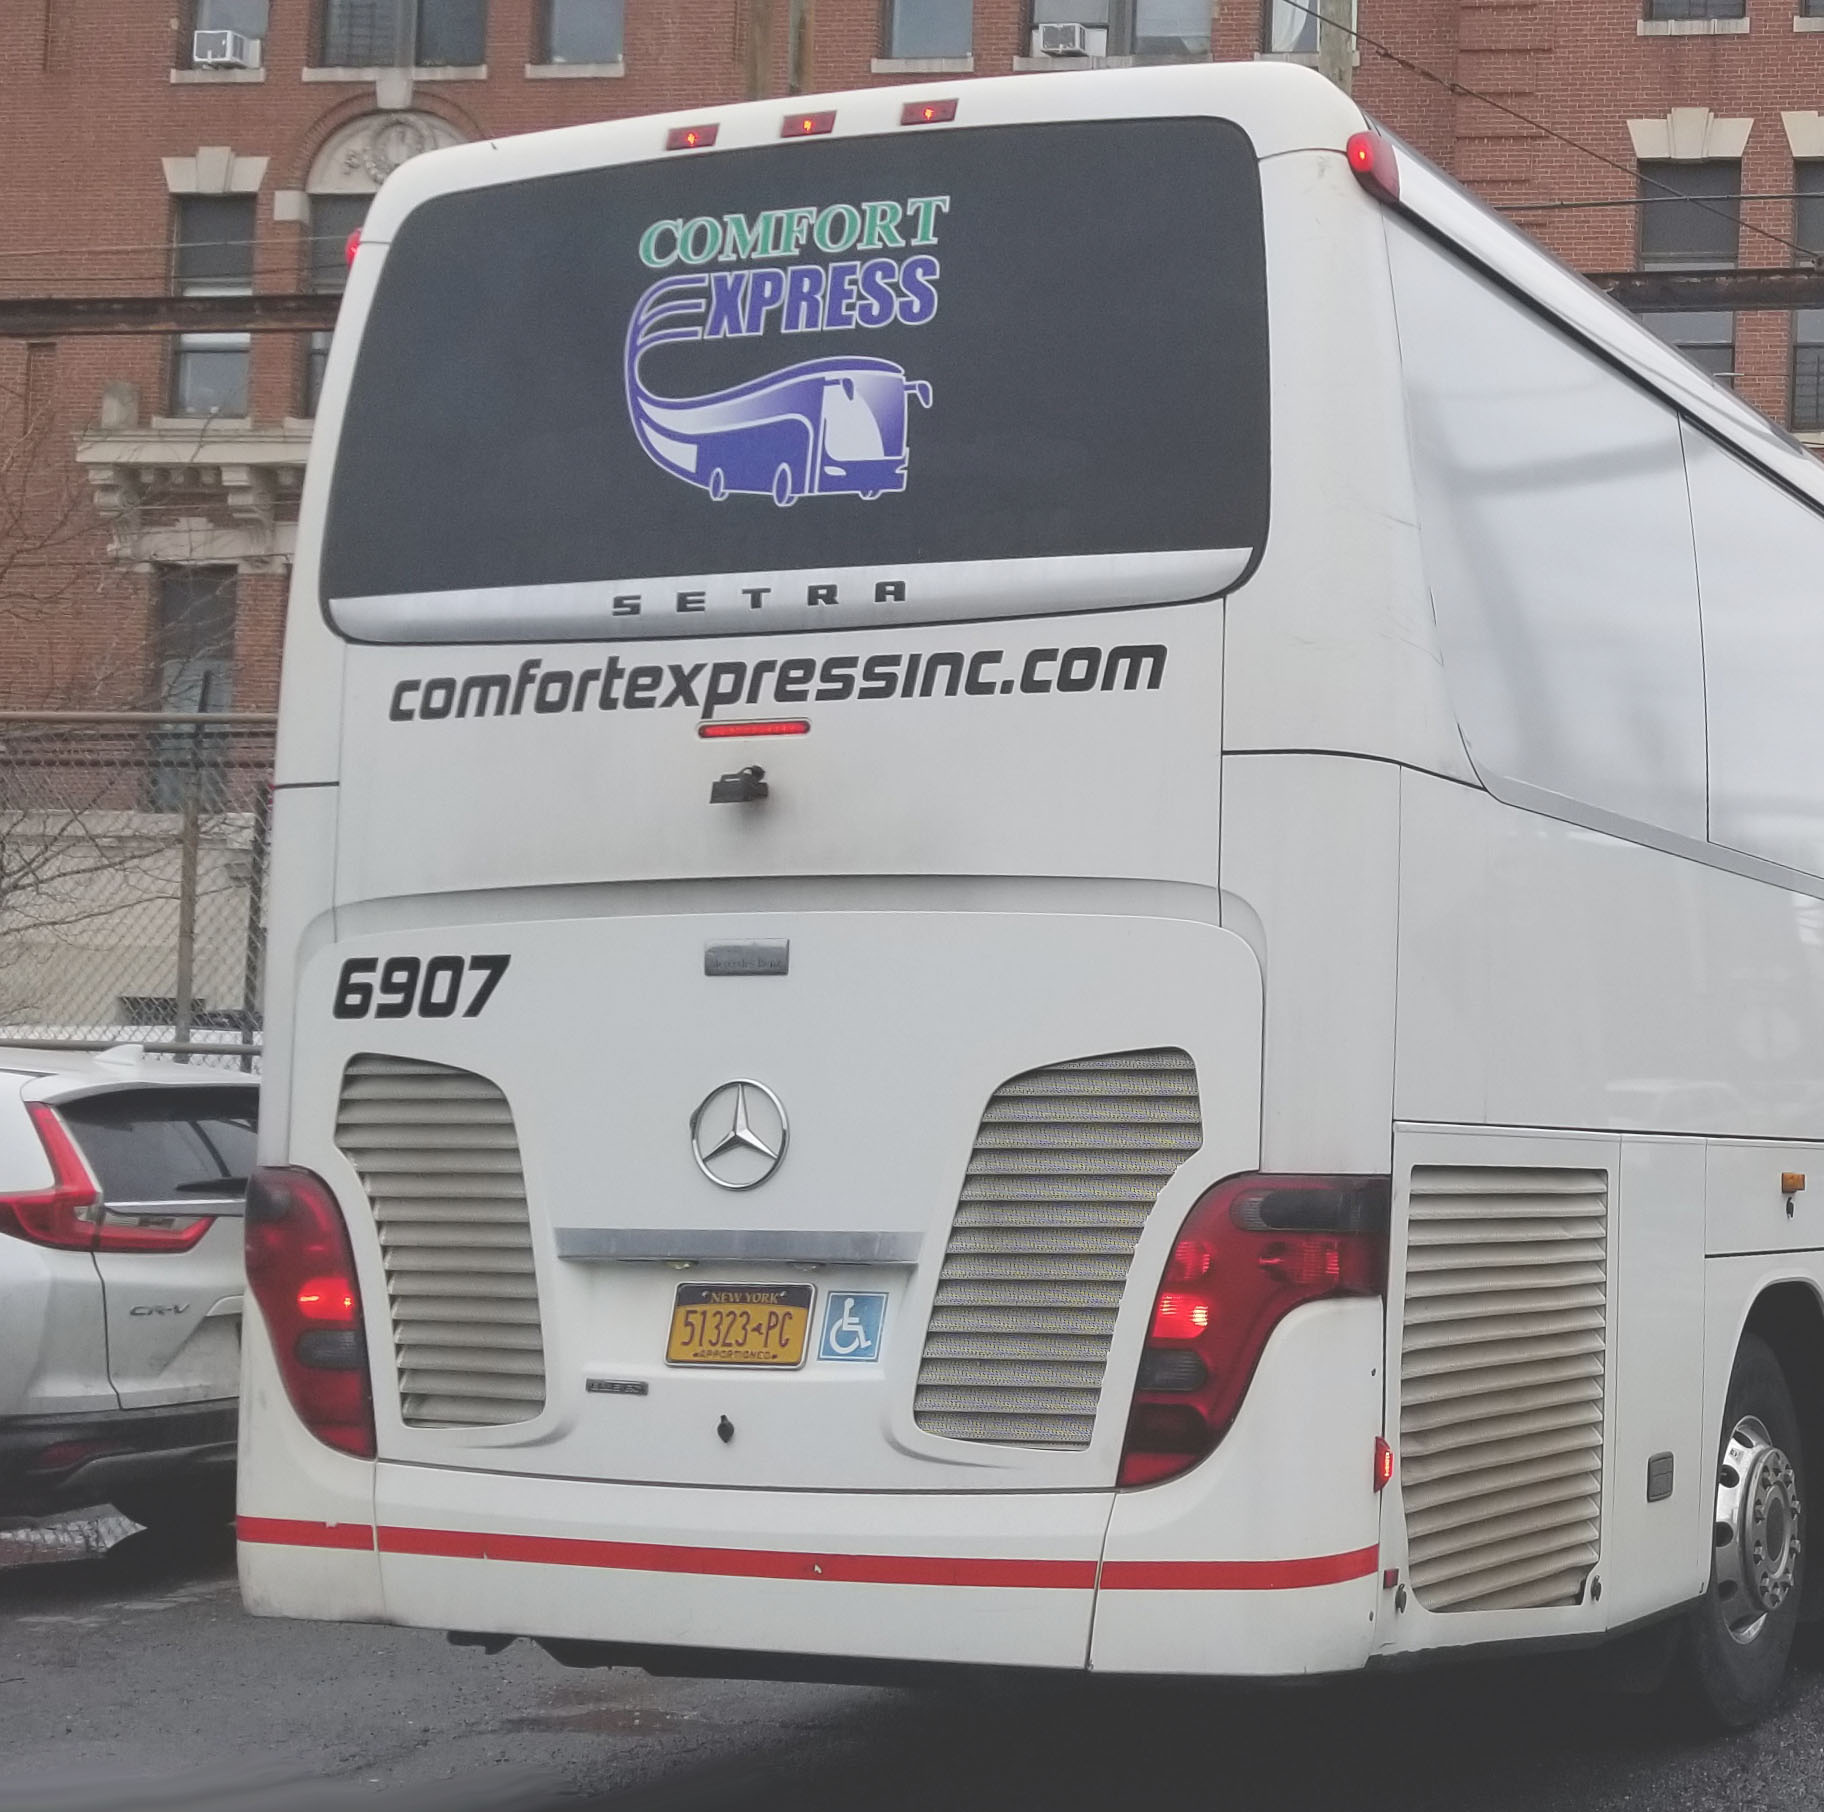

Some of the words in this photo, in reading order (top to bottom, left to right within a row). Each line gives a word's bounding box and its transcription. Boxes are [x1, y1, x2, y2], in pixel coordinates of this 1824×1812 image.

[638, 195, 950, 268] COMFORT
[625, 254, 940, 346] EXPRESS
[612, 580, 907, 616] SETRA
[389, 644, 1168, 720] comfortexpressinc.com
[333, 954, 511, 1020] 6907
[129, 1303, 190, 1317] CR-V
[709, 1291, 743, 1304] NEW
[744, 1291, 780, 1304] YORK
